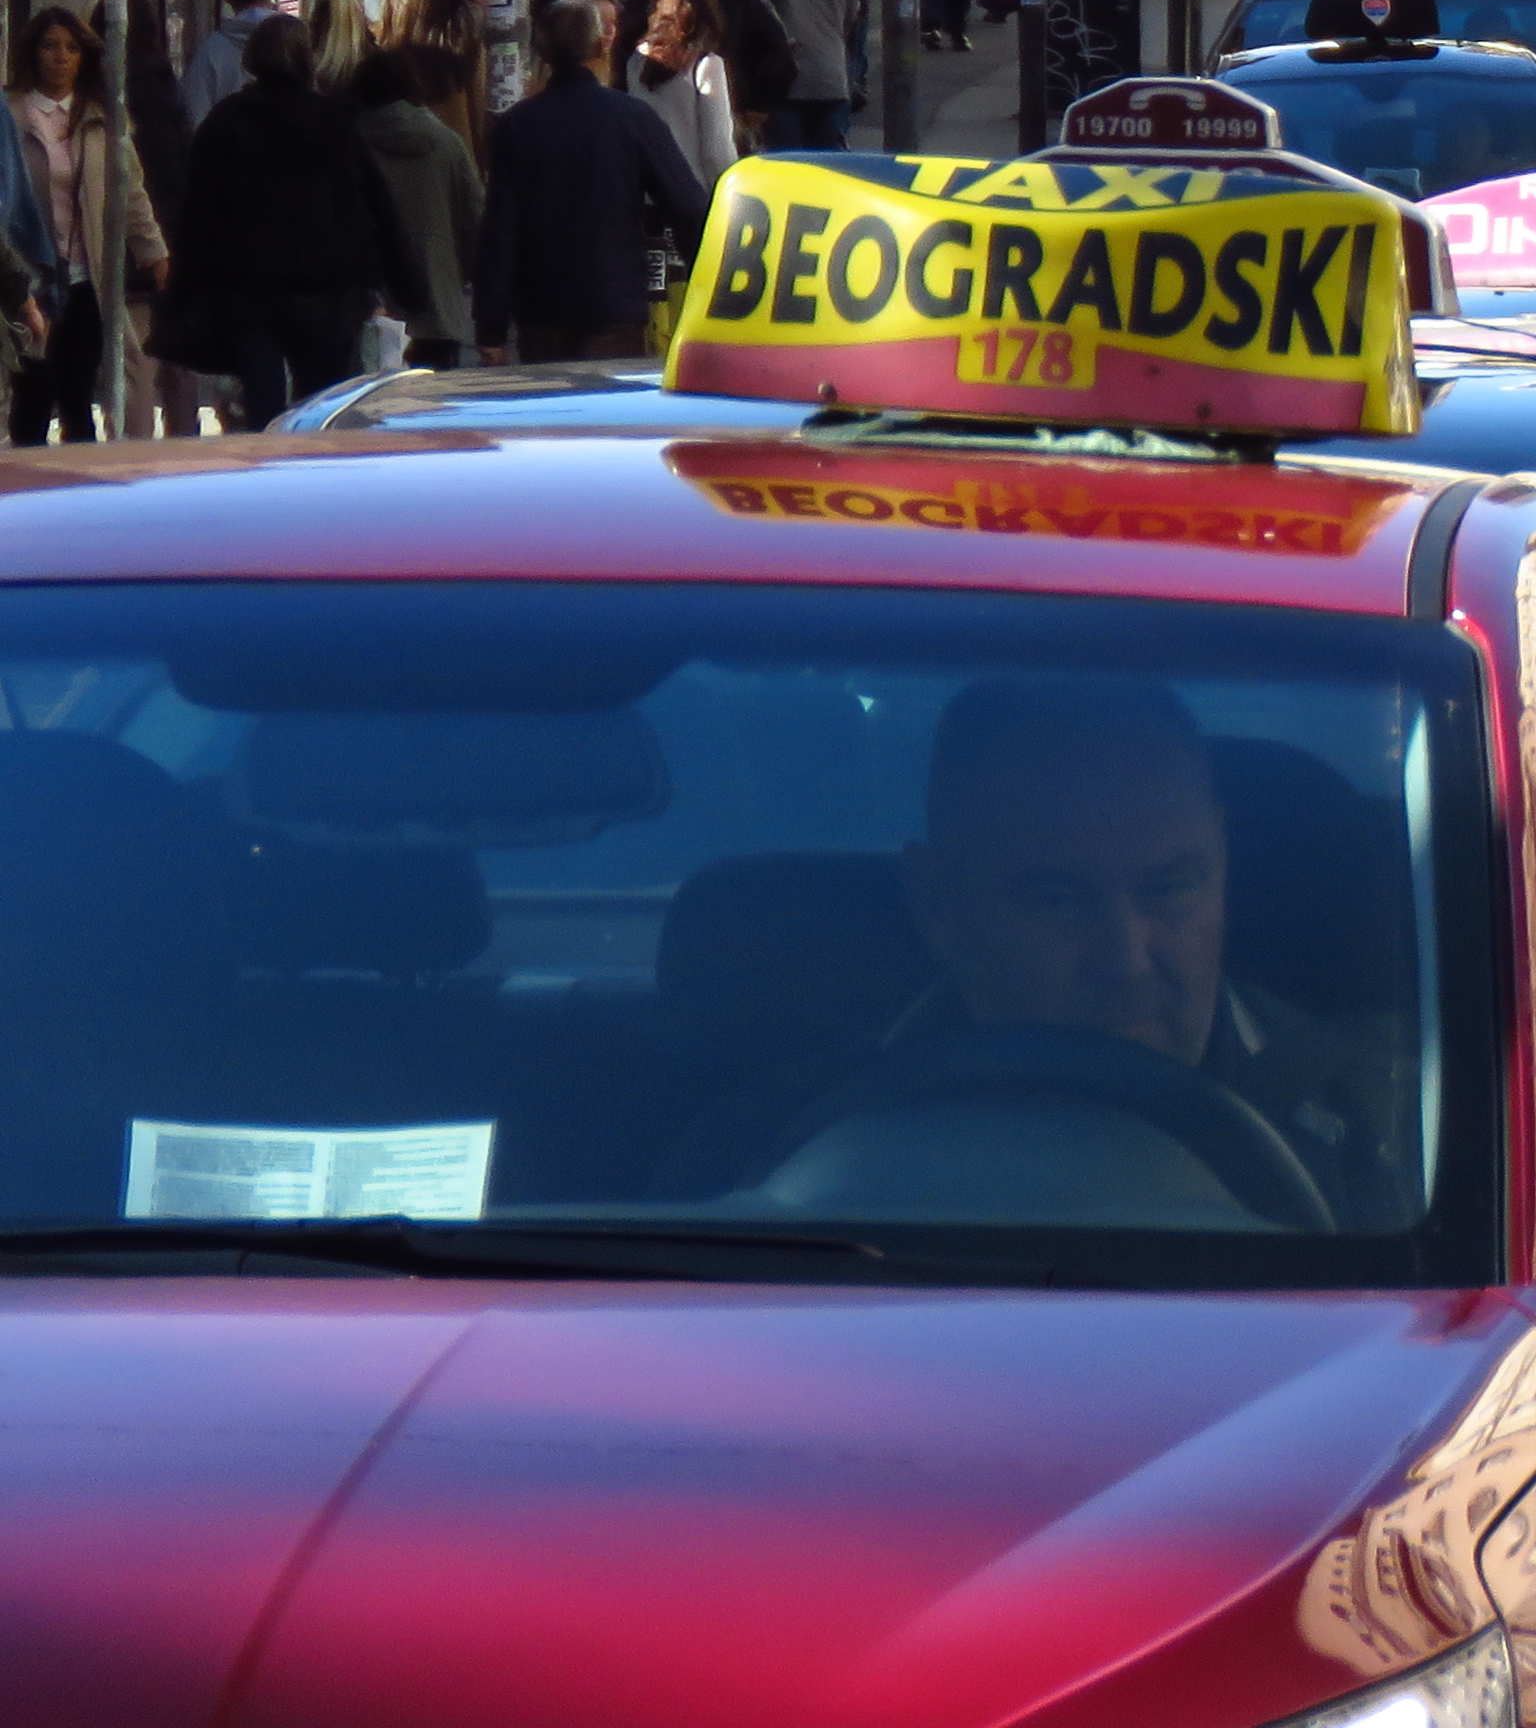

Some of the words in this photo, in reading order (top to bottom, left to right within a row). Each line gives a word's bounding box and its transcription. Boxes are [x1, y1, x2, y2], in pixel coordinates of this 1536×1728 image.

[1074, 114, 1153, 140] 19700
[1182, 117, 1258, 140] 19999
[894, 154, 1228, 212] TAXI
[706, 192, 1378, 358] BEOGRADSKI
[972, 327, 1077, 386] 178
